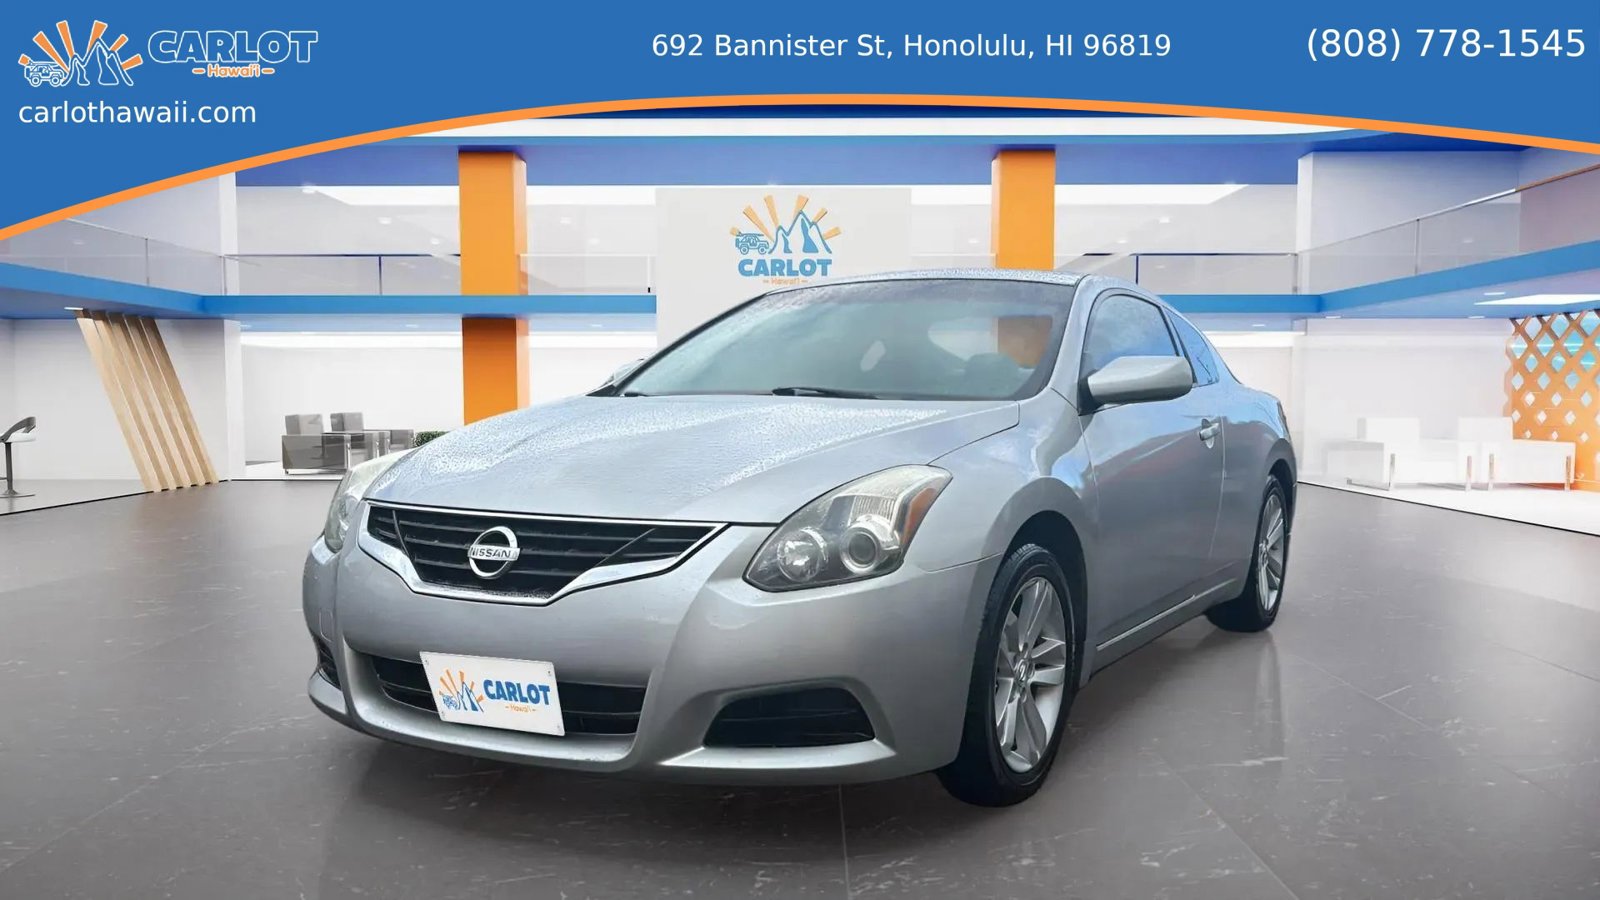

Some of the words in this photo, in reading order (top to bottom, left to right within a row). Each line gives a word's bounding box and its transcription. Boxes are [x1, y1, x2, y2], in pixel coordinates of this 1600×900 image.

[738, 258, 832, 277] CARLOT
[470, 546, 512, 559] NISSAN
[483, 679, 551, 706] CARLOT
